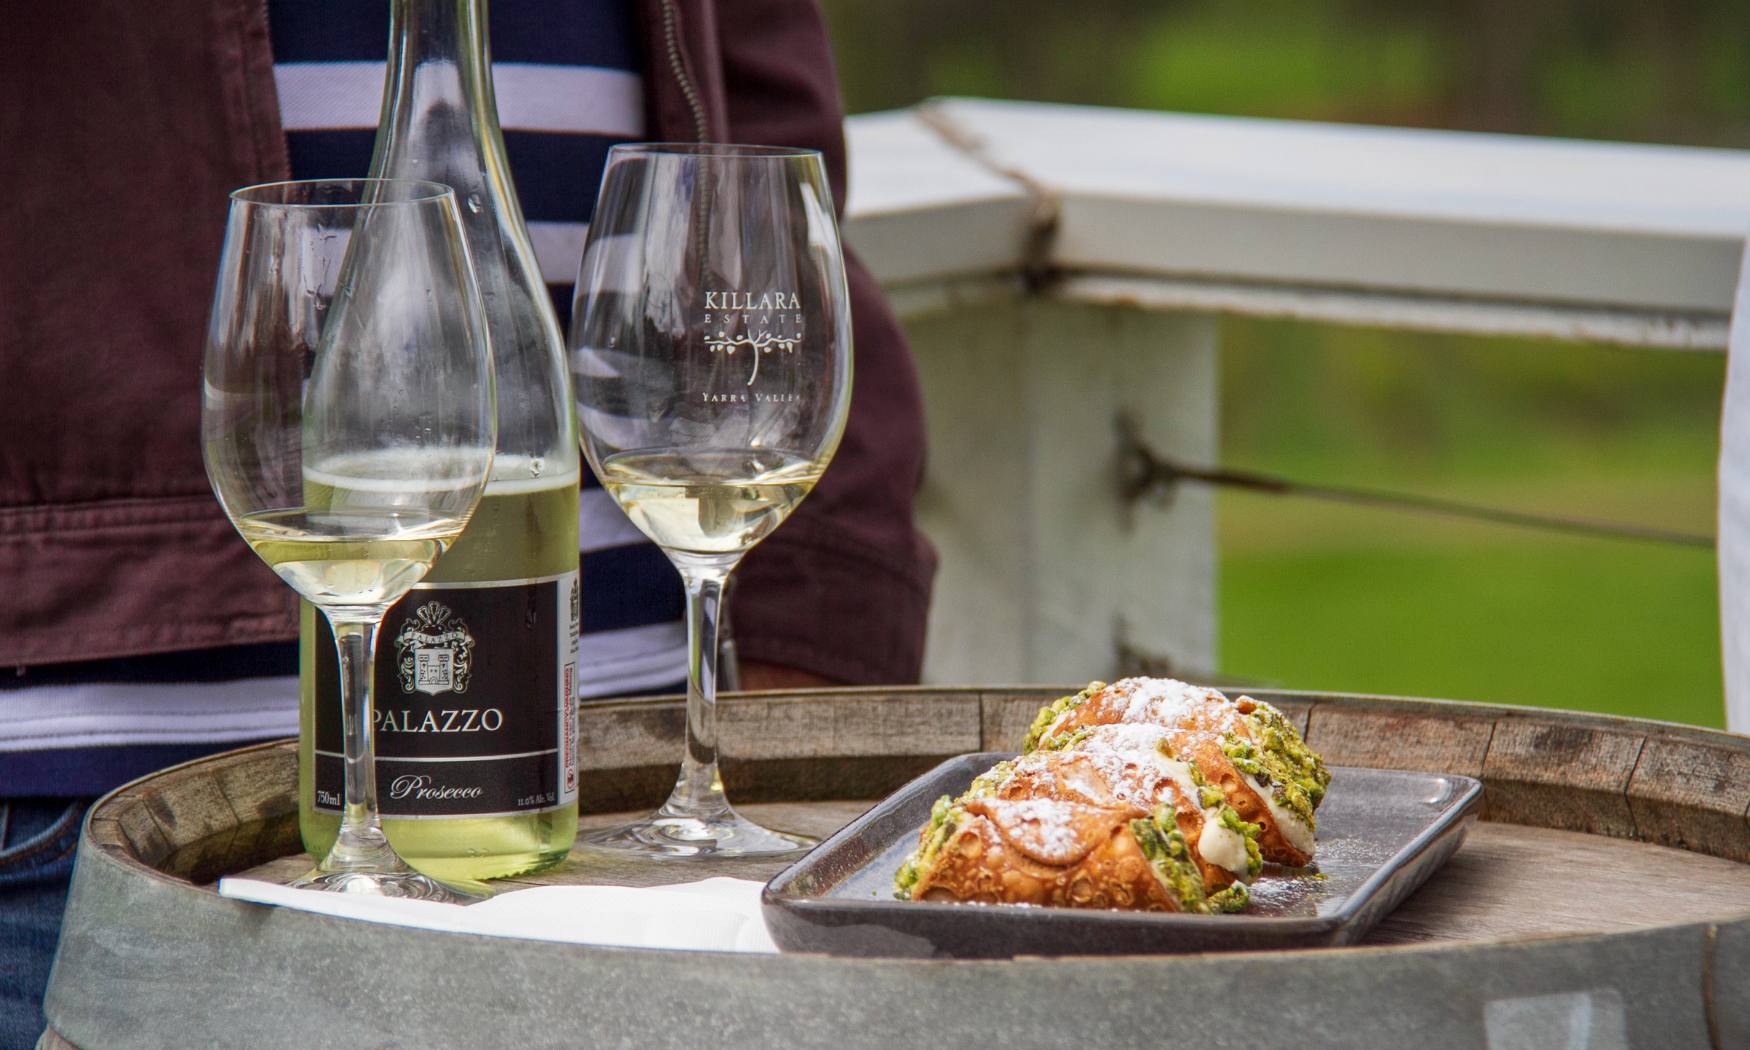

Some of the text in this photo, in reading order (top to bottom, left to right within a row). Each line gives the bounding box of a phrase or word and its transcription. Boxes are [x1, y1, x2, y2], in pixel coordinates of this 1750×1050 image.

[704, 291, 801, 310] KILLARA
[704, 313, 802, 324] ESTATE
[372, 708, 503, 732] PALAZZO
[390, 774, 483, 799] Prosecco
[317, 790, 340, 806] 750ml
